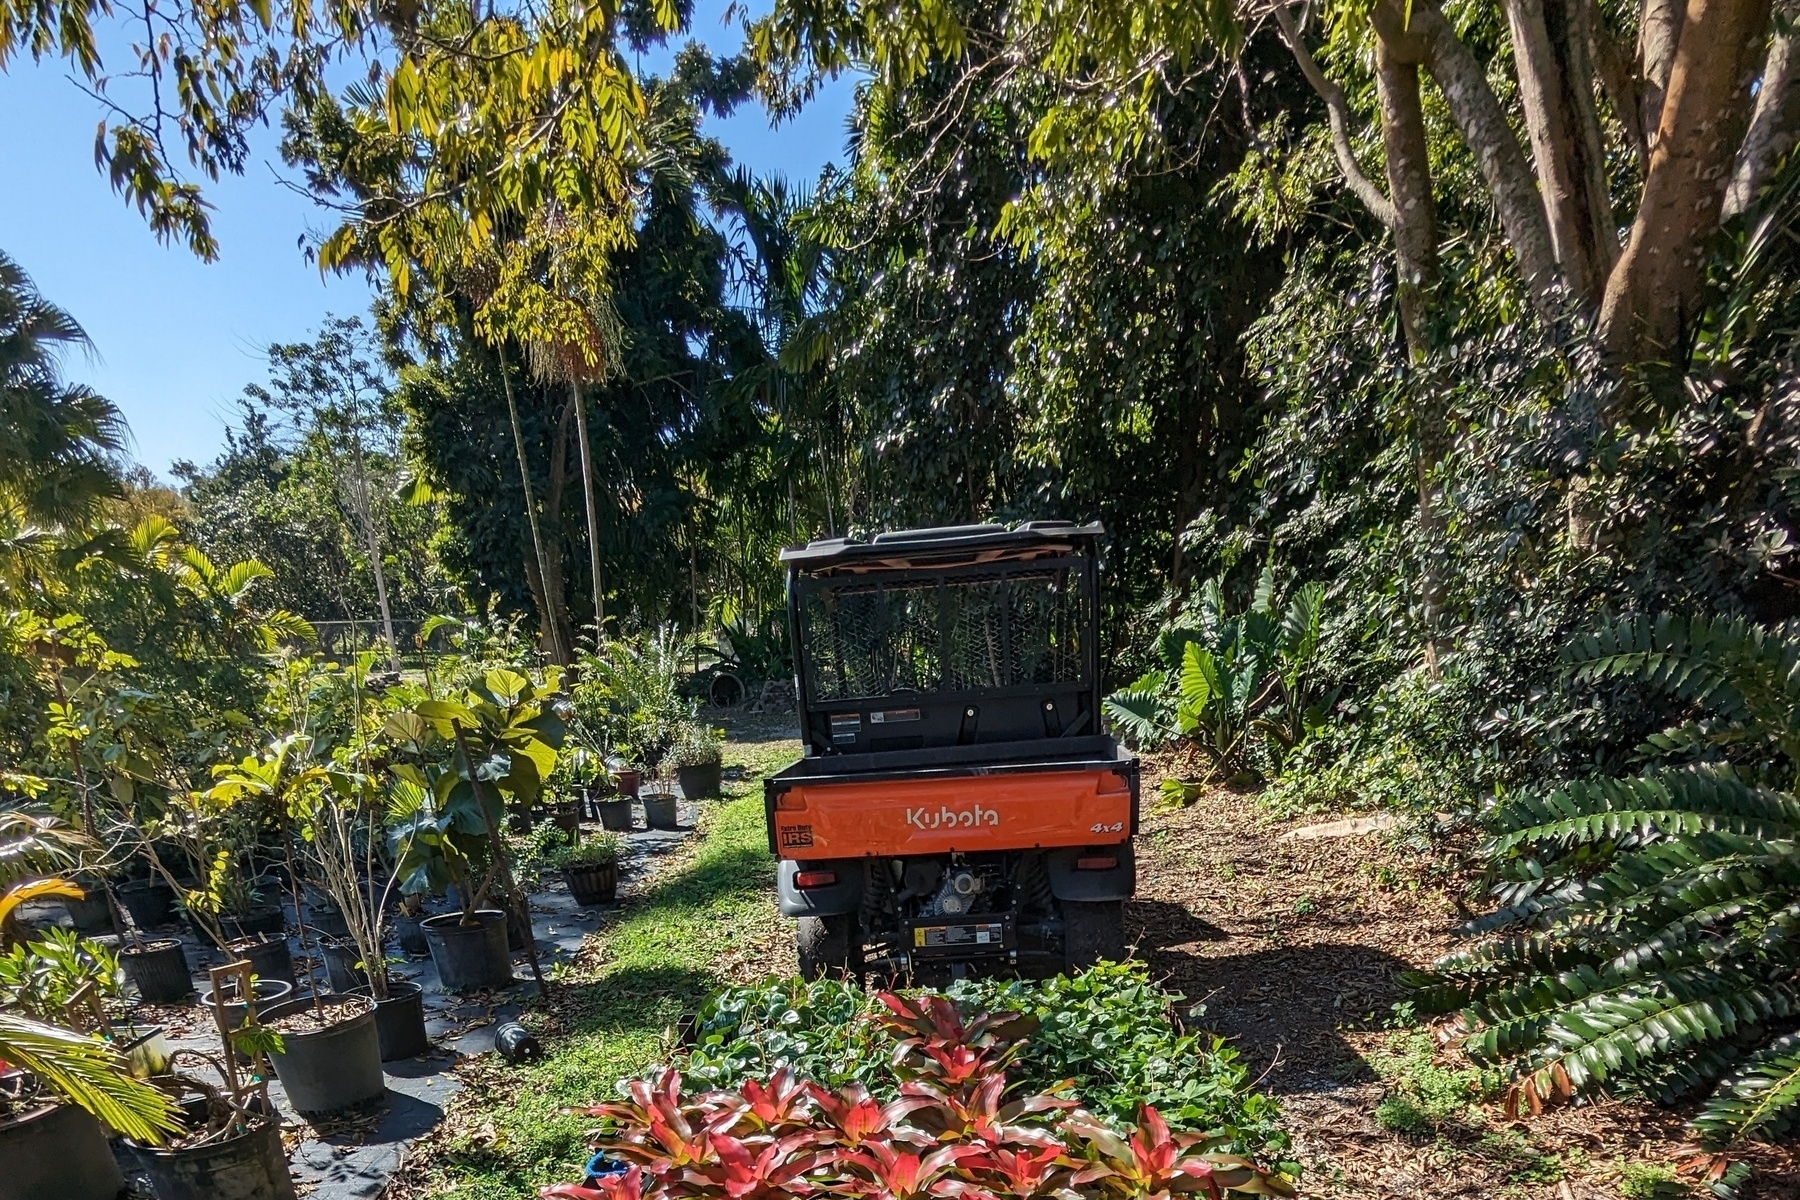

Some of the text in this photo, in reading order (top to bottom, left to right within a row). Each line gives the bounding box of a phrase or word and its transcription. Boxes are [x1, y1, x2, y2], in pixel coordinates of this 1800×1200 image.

[906, 804, 999, 830] Kubota
[1090, 822, 1124, 834] 4x4
[782, 833, 812, 844] IRS
